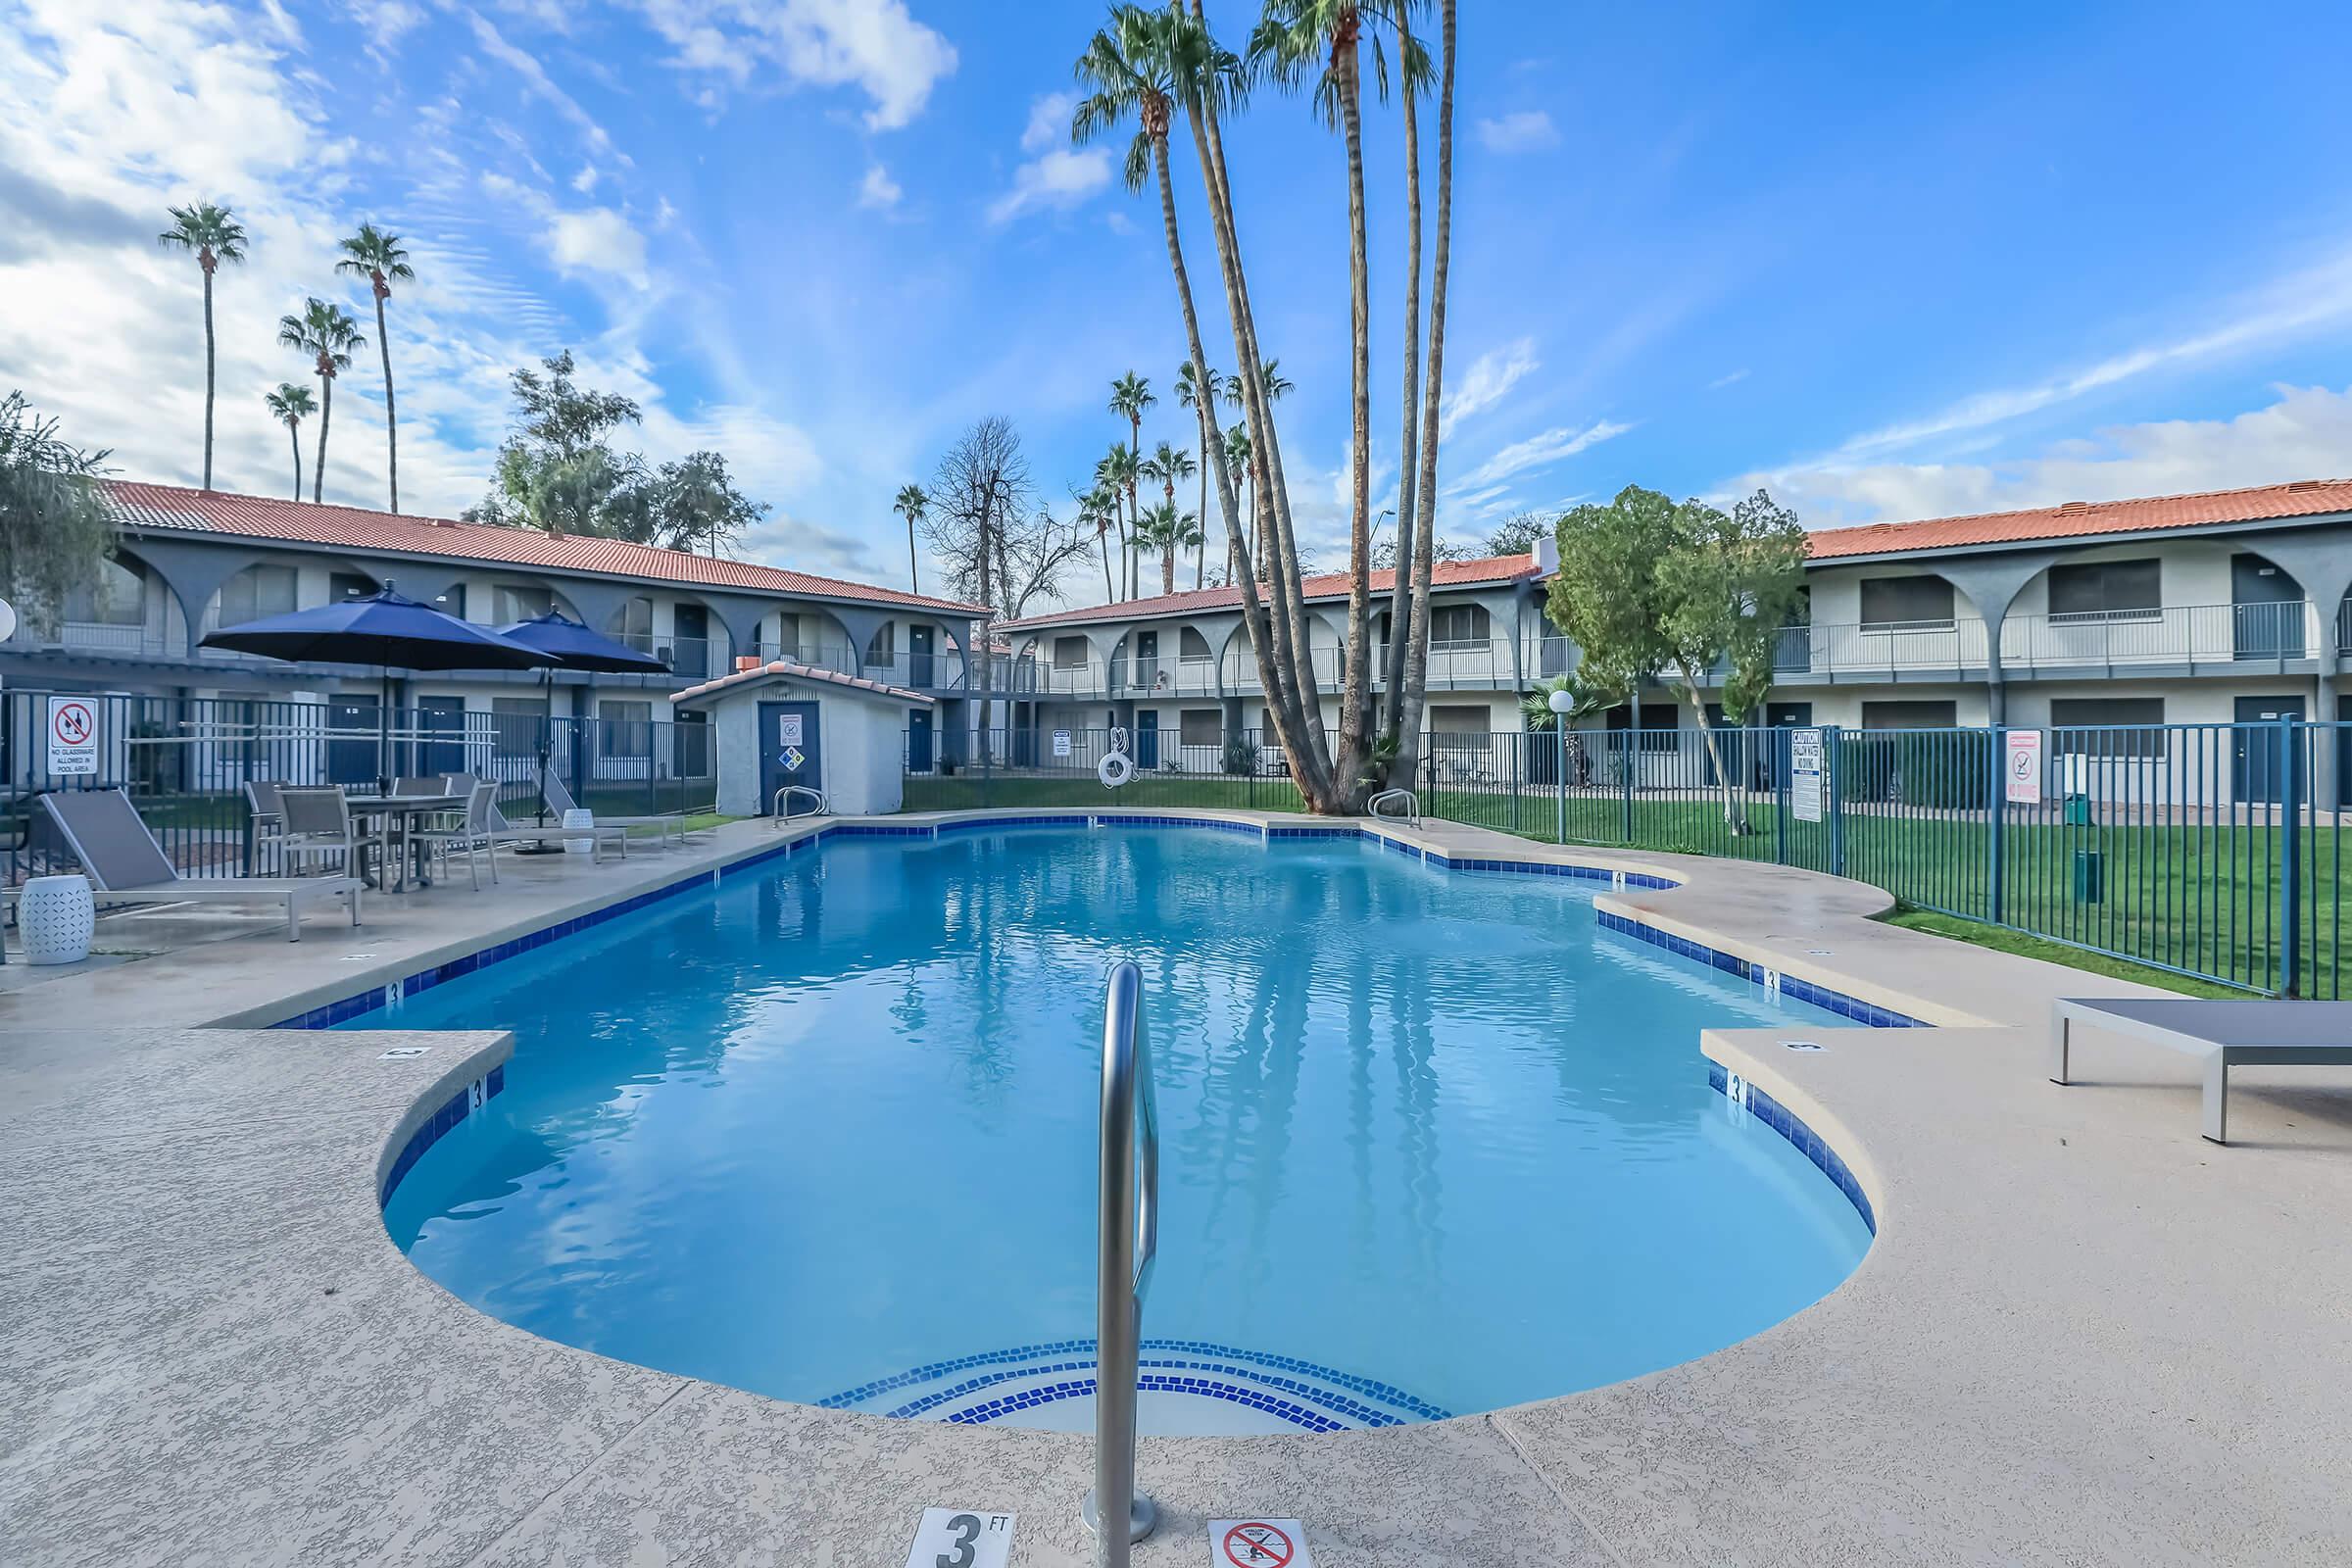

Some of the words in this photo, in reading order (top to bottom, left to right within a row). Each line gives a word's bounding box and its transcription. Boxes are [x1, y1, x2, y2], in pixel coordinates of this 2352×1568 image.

[1794, 732, 1819, 744] CAUTION
[1793, 745, 1807, 757] SHALLOW
[1808, 745, 1819, 757] WATER
[1803, 758, 1814, 769] DIVING
[1616, 872, 1621, 882] 4
[1768, 971, 1775, 989] 3
[391, 983, 398, 1004] 3
[474, 1079, 481, 1108] 3
[1732, 1074, 1740, 1102] 3
[936, 1514, 981, 1568] 3
[989, 1516, 1008, 1531] FT
